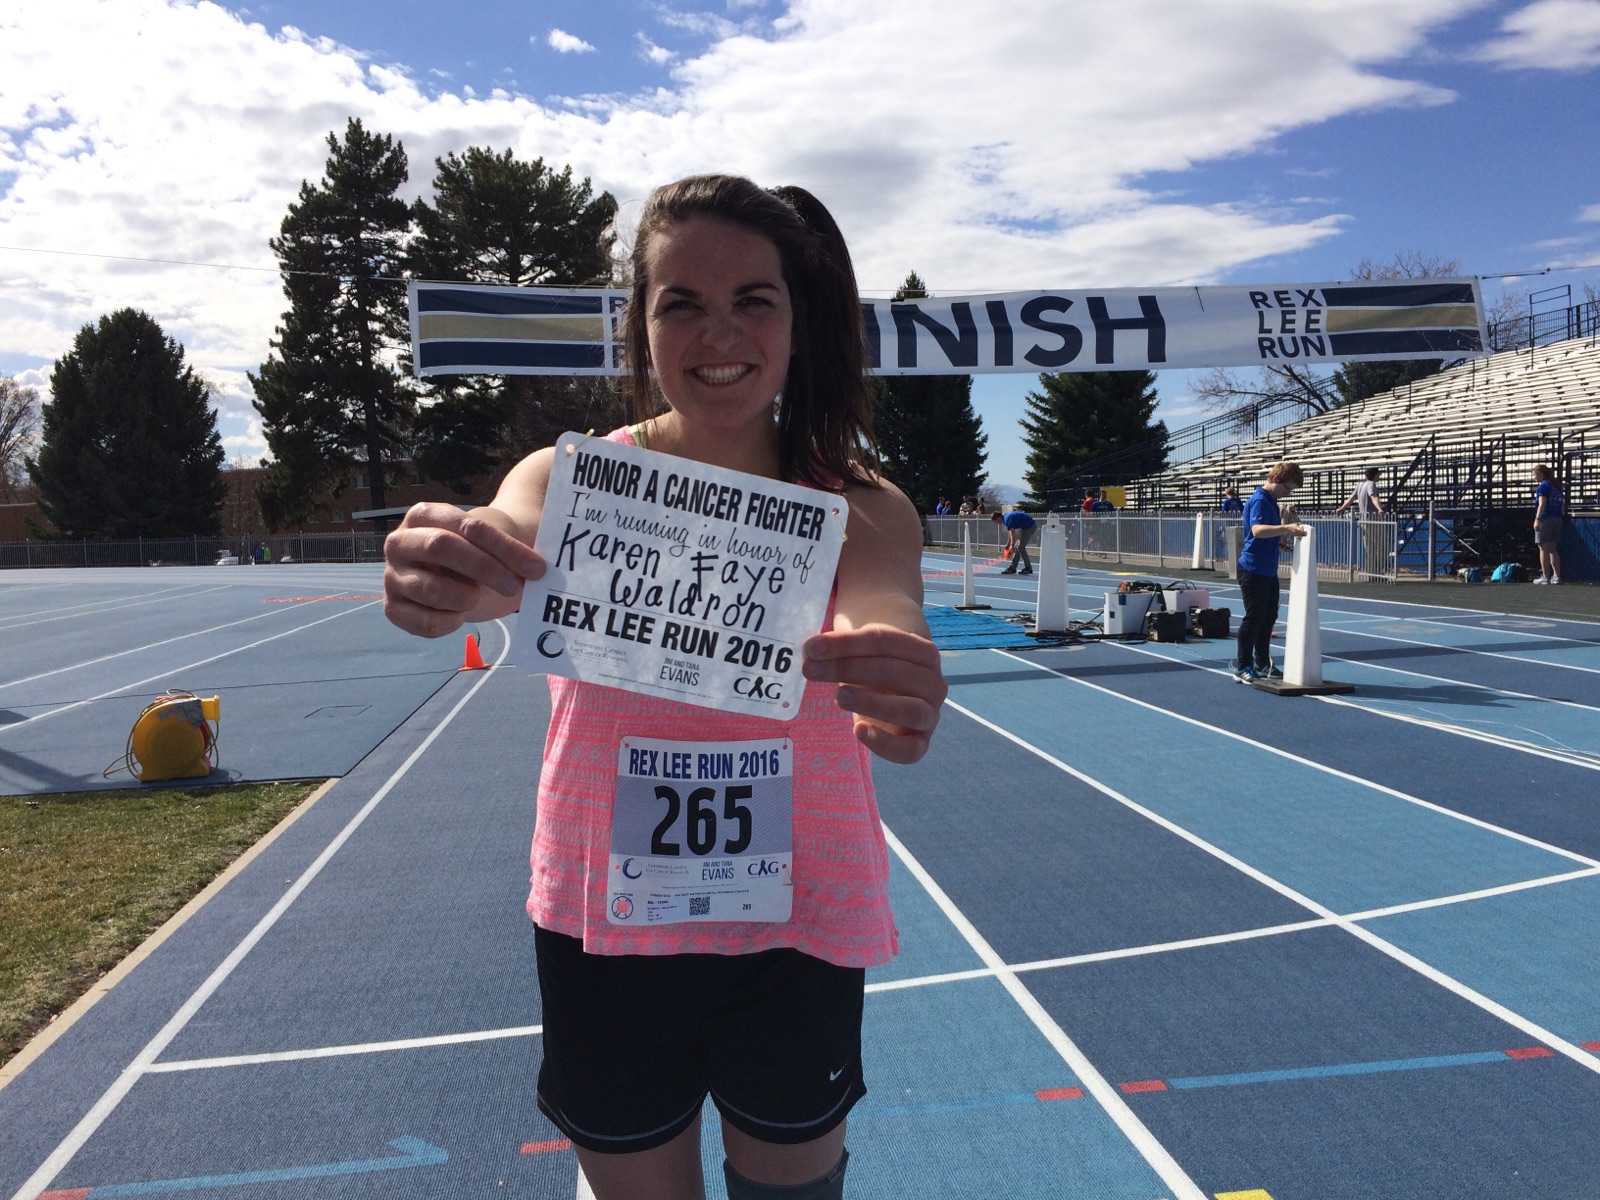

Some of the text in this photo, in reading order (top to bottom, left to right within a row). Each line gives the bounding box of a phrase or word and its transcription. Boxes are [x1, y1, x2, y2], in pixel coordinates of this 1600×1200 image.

[1249, 288, 1324, 309] REX
[1258, 309, 1321, 334] LEE
[859, 296, 1166, 368] INISH
[1257, 335, 1327, 359] RUN
[572, 452, 826, 541] HONOR A CANCER FIGHTER
[566, 491, 815, 584] I'm running in honor of
[555, 522, 785, 607] Karen Faye
[610, 569, 765, 632] Waldron
[542, 594, 793, 673] REX LEE RUN 2016
[660, 665, 700, 686] EVANS
[673, 659, 684, 668] AND
[685, 661, 700, 671] TANA
[629, 748, 779, 779] REX LEE RUN 2016
[651, 785, 752, 856] 265
[702, 867, 734, 880] EVANS
